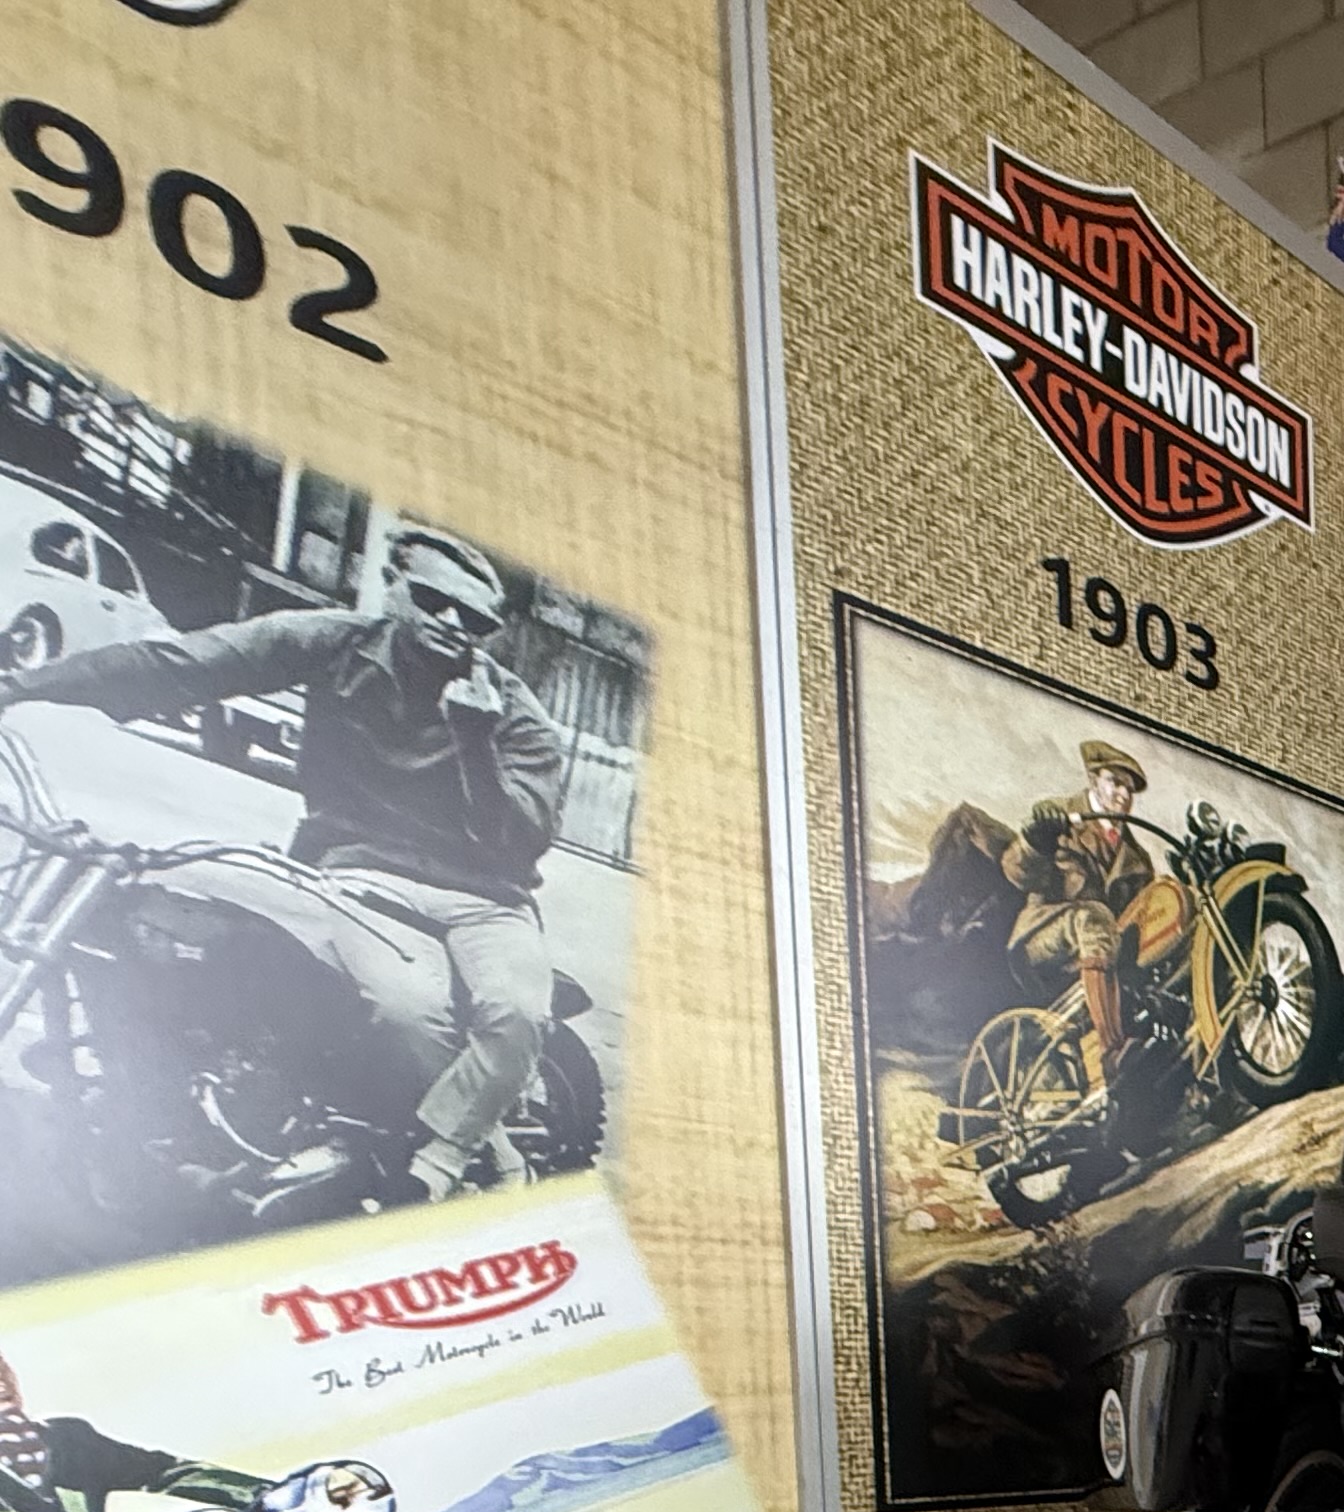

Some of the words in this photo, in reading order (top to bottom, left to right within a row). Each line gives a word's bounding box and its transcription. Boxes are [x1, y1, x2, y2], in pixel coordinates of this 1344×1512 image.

[1042, 203, 1220, 359] MOTOR
[950, 214, 1291, 488] HARLEY-DAVIDSON
[1047, 372, 1223, 513] CYCLES
[1042, 556, 1219, 691] 1903
[261, 1239, 578, 1344] TRIUMPH
[313, 1369, 352, 1395] The
[509, 1329, 523, 1342] in
[531, 1319, 550, 1336] the
